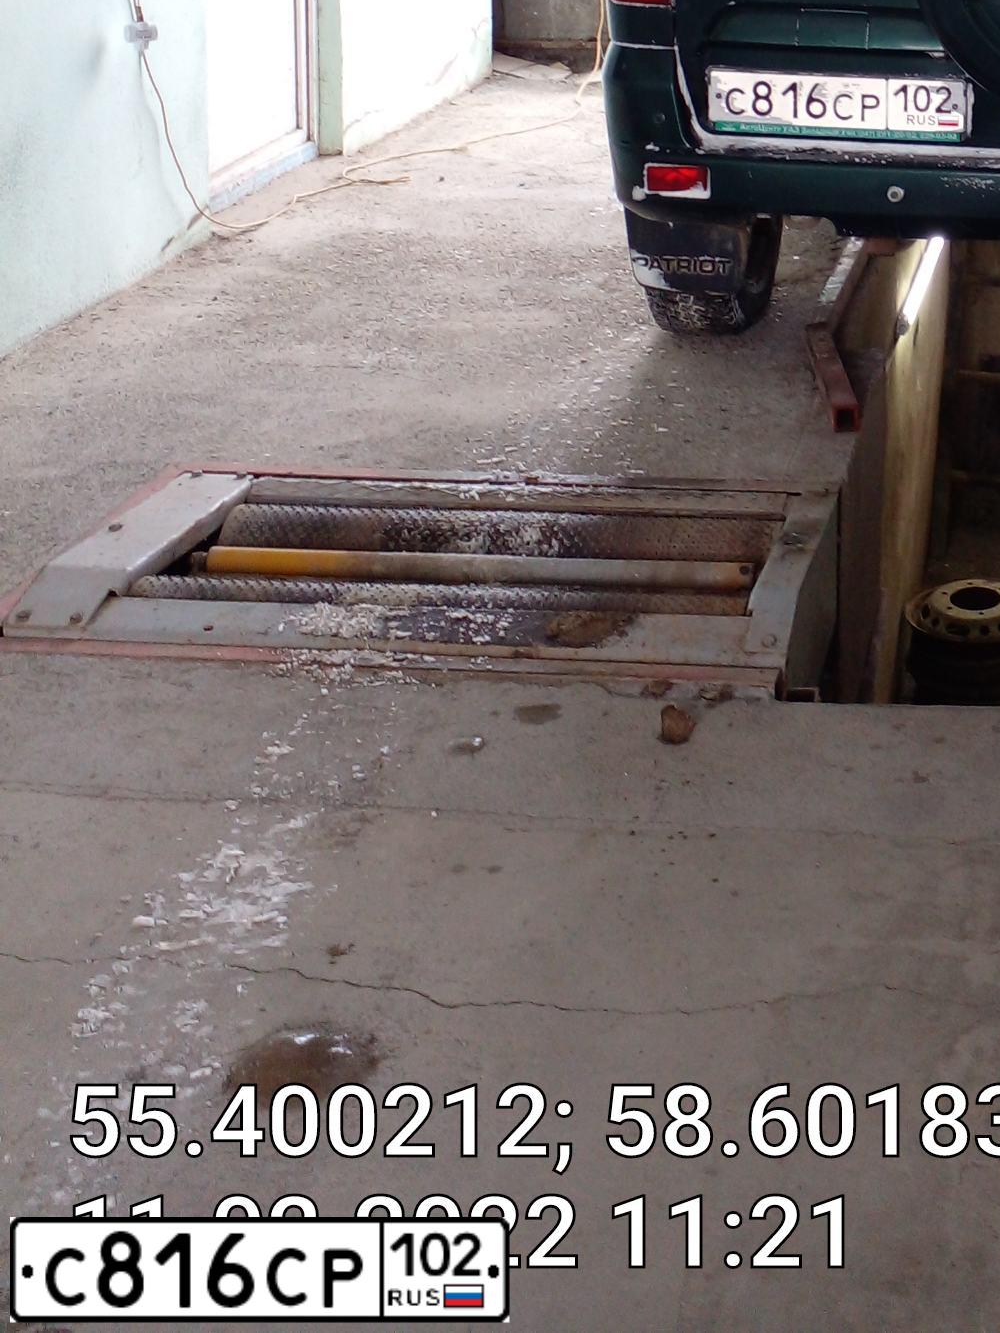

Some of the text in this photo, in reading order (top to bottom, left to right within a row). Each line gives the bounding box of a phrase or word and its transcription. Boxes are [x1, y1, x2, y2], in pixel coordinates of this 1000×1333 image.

[893, 83, 952, 115] 102
[905, 114, 936, 126] RUS
[632, 255, 732, 275] PATRIOT
